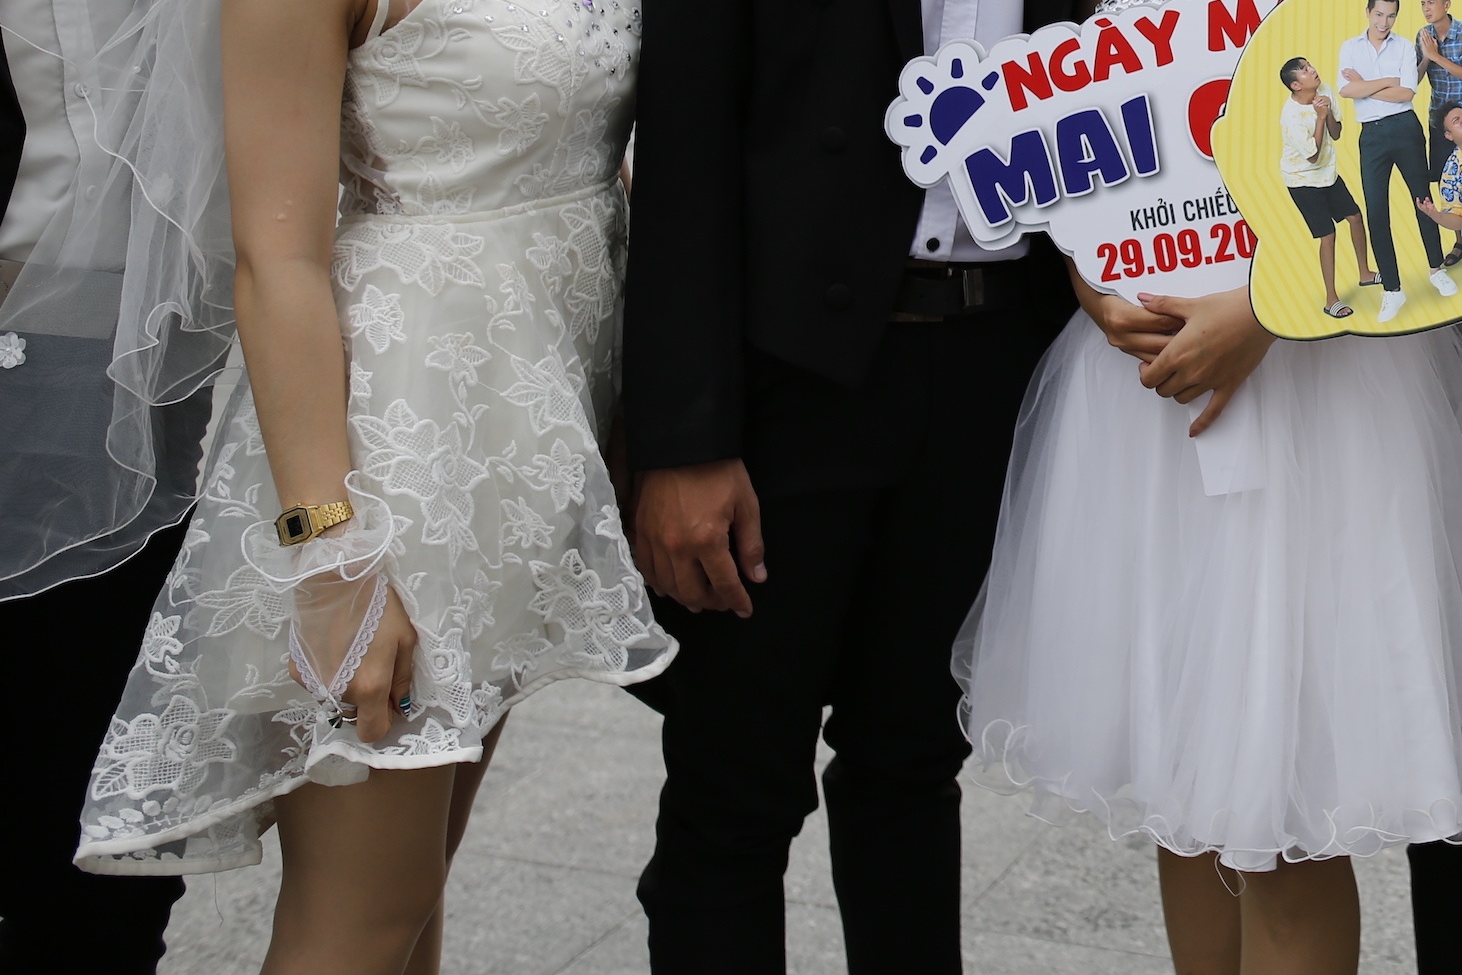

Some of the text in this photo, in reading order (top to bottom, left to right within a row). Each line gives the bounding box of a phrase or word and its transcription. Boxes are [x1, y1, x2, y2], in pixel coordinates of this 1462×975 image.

[1001, 10, 1180, 112] NGÀY
[964, 95, 1158, 225] MAI
[1129, 197, 1177, 231] KHỞI
